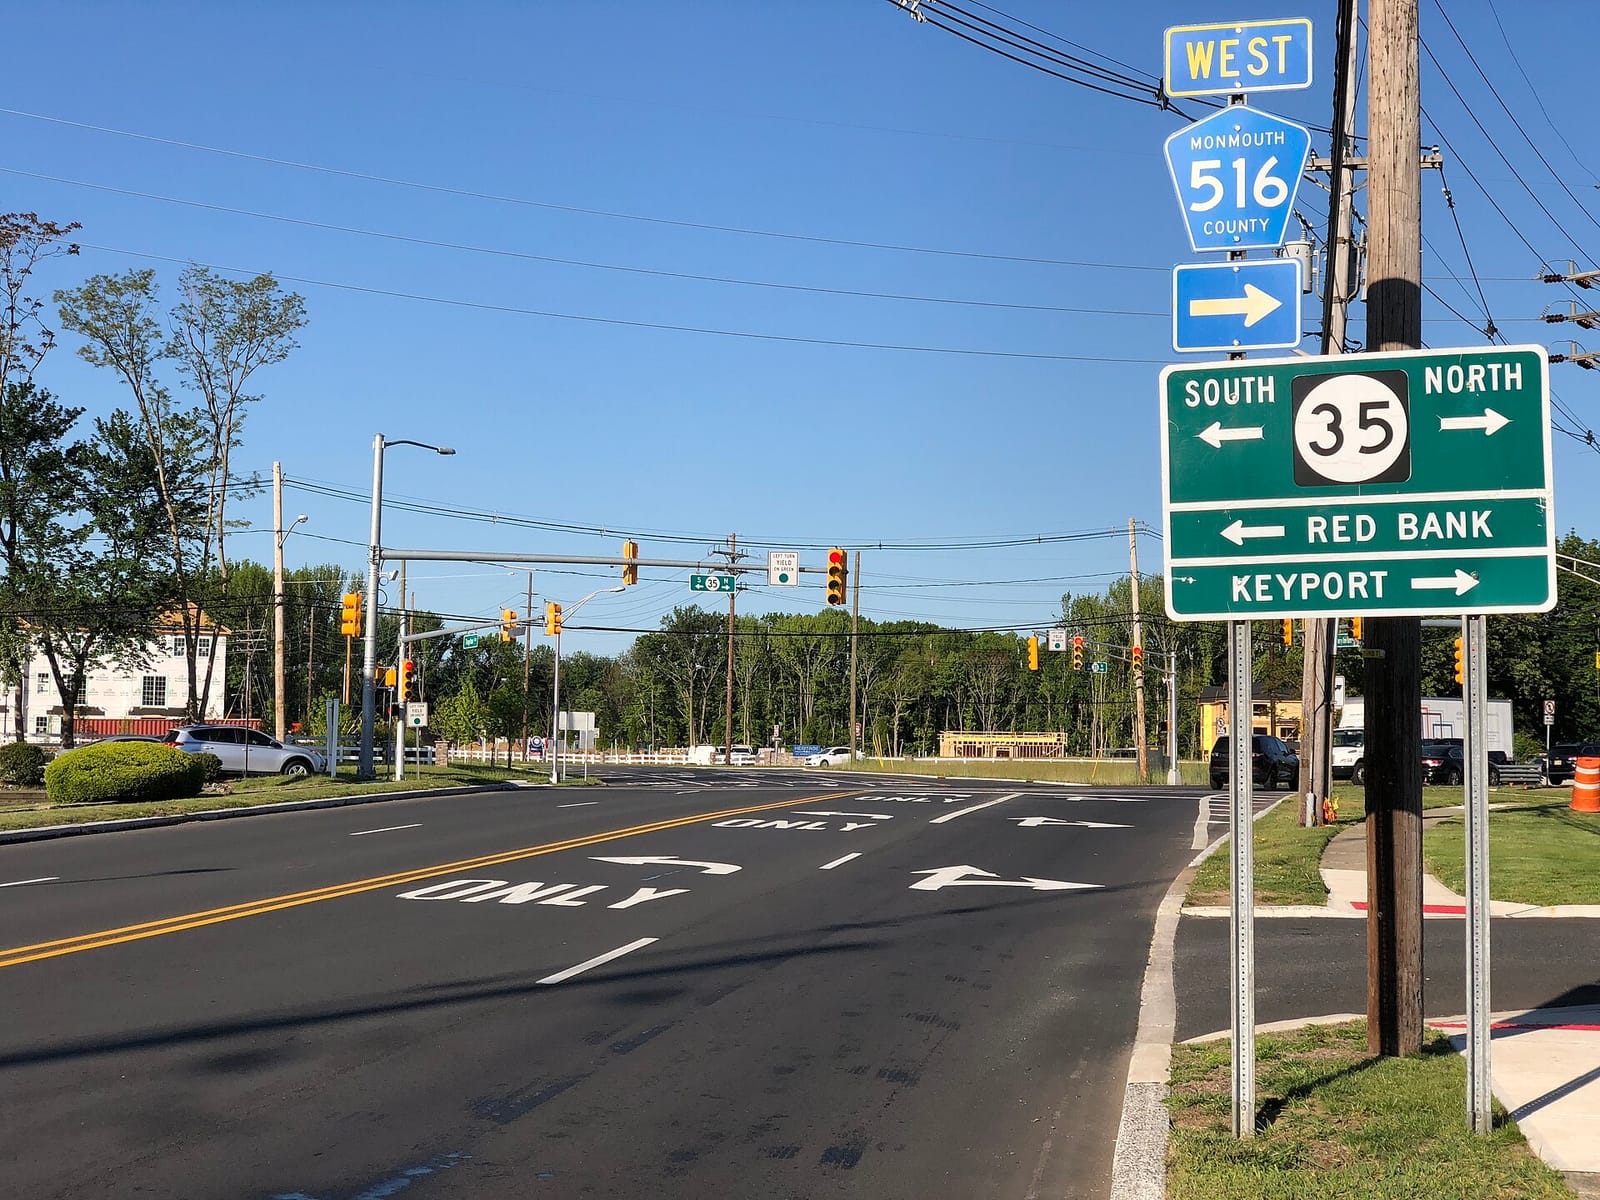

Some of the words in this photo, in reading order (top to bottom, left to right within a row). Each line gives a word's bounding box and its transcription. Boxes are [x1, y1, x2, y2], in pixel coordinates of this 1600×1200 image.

[1186, 35, 1292, 80] WEST
[1191, 131, 1285, 150] MONMOUTH
[1190, 155, 1288, 212] 516
[1203, 218, 1270, 235] COUNTY
[1184, 375, 1275, 407] SOUTH
[1309, 401, 1393, 456] 35
[1424, 362, 1523, 394] NORTH
[1307, 515, 1376, 544] RED
[1398, 510, 1494, 541] BANK
[707, 579, 718, 588] 35
[1232, 571, 1388, 602] KEYPORT
[711, 818, 878, 832] ONLY
[396, 879, 690, 909] ONLY
